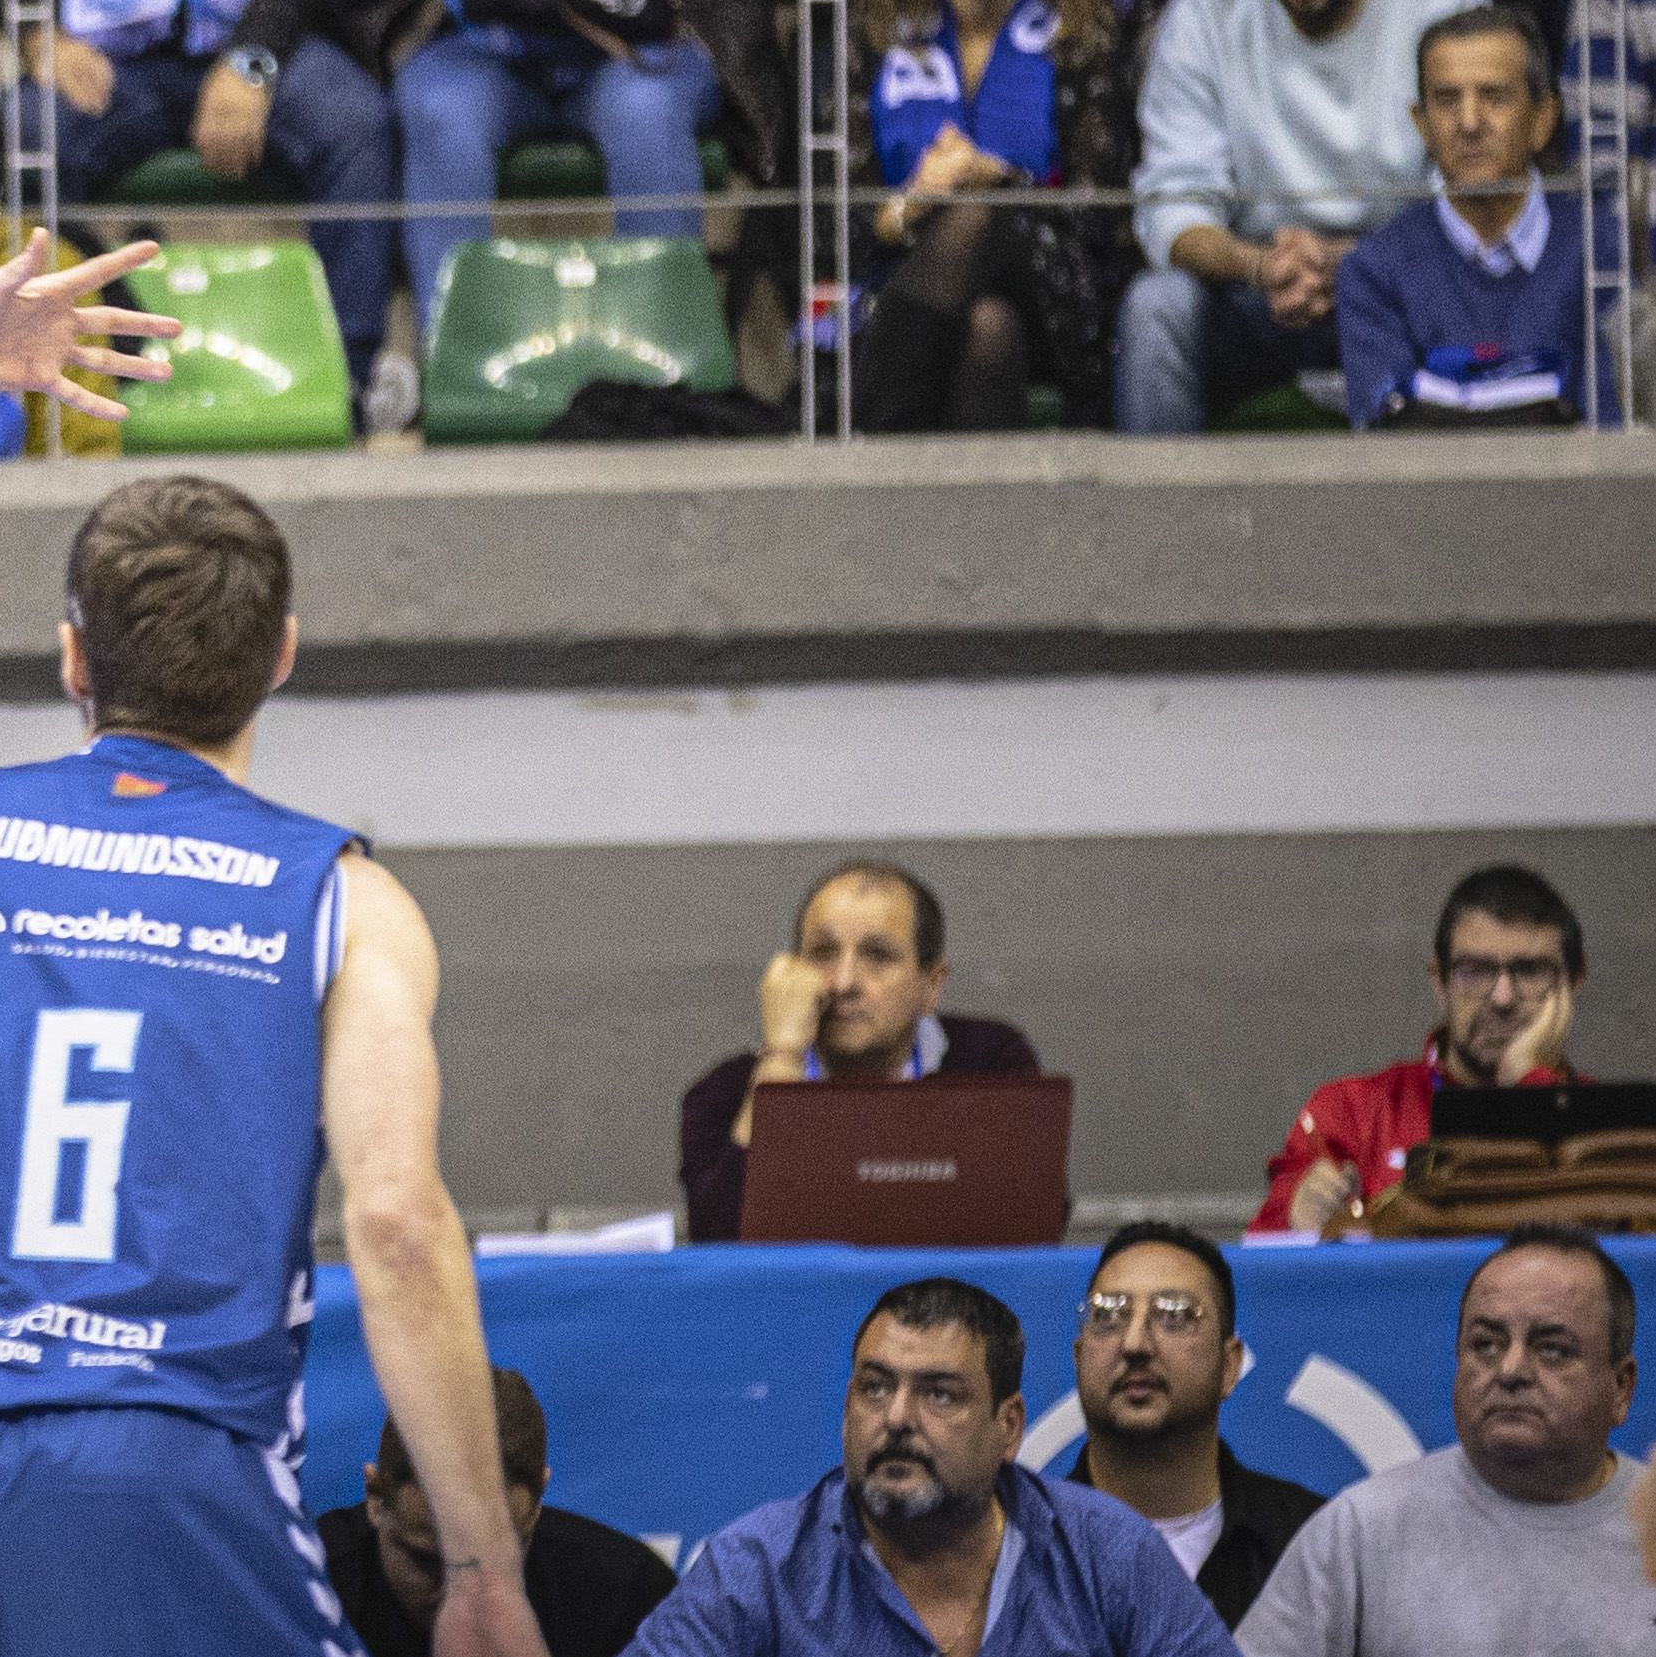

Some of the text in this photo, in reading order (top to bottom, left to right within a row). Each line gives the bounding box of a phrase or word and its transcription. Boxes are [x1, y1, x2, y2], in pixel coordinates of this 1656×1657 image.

[12, 908, 287, 964] recoletas salud
[11, 1008, 144, 1263] 6
